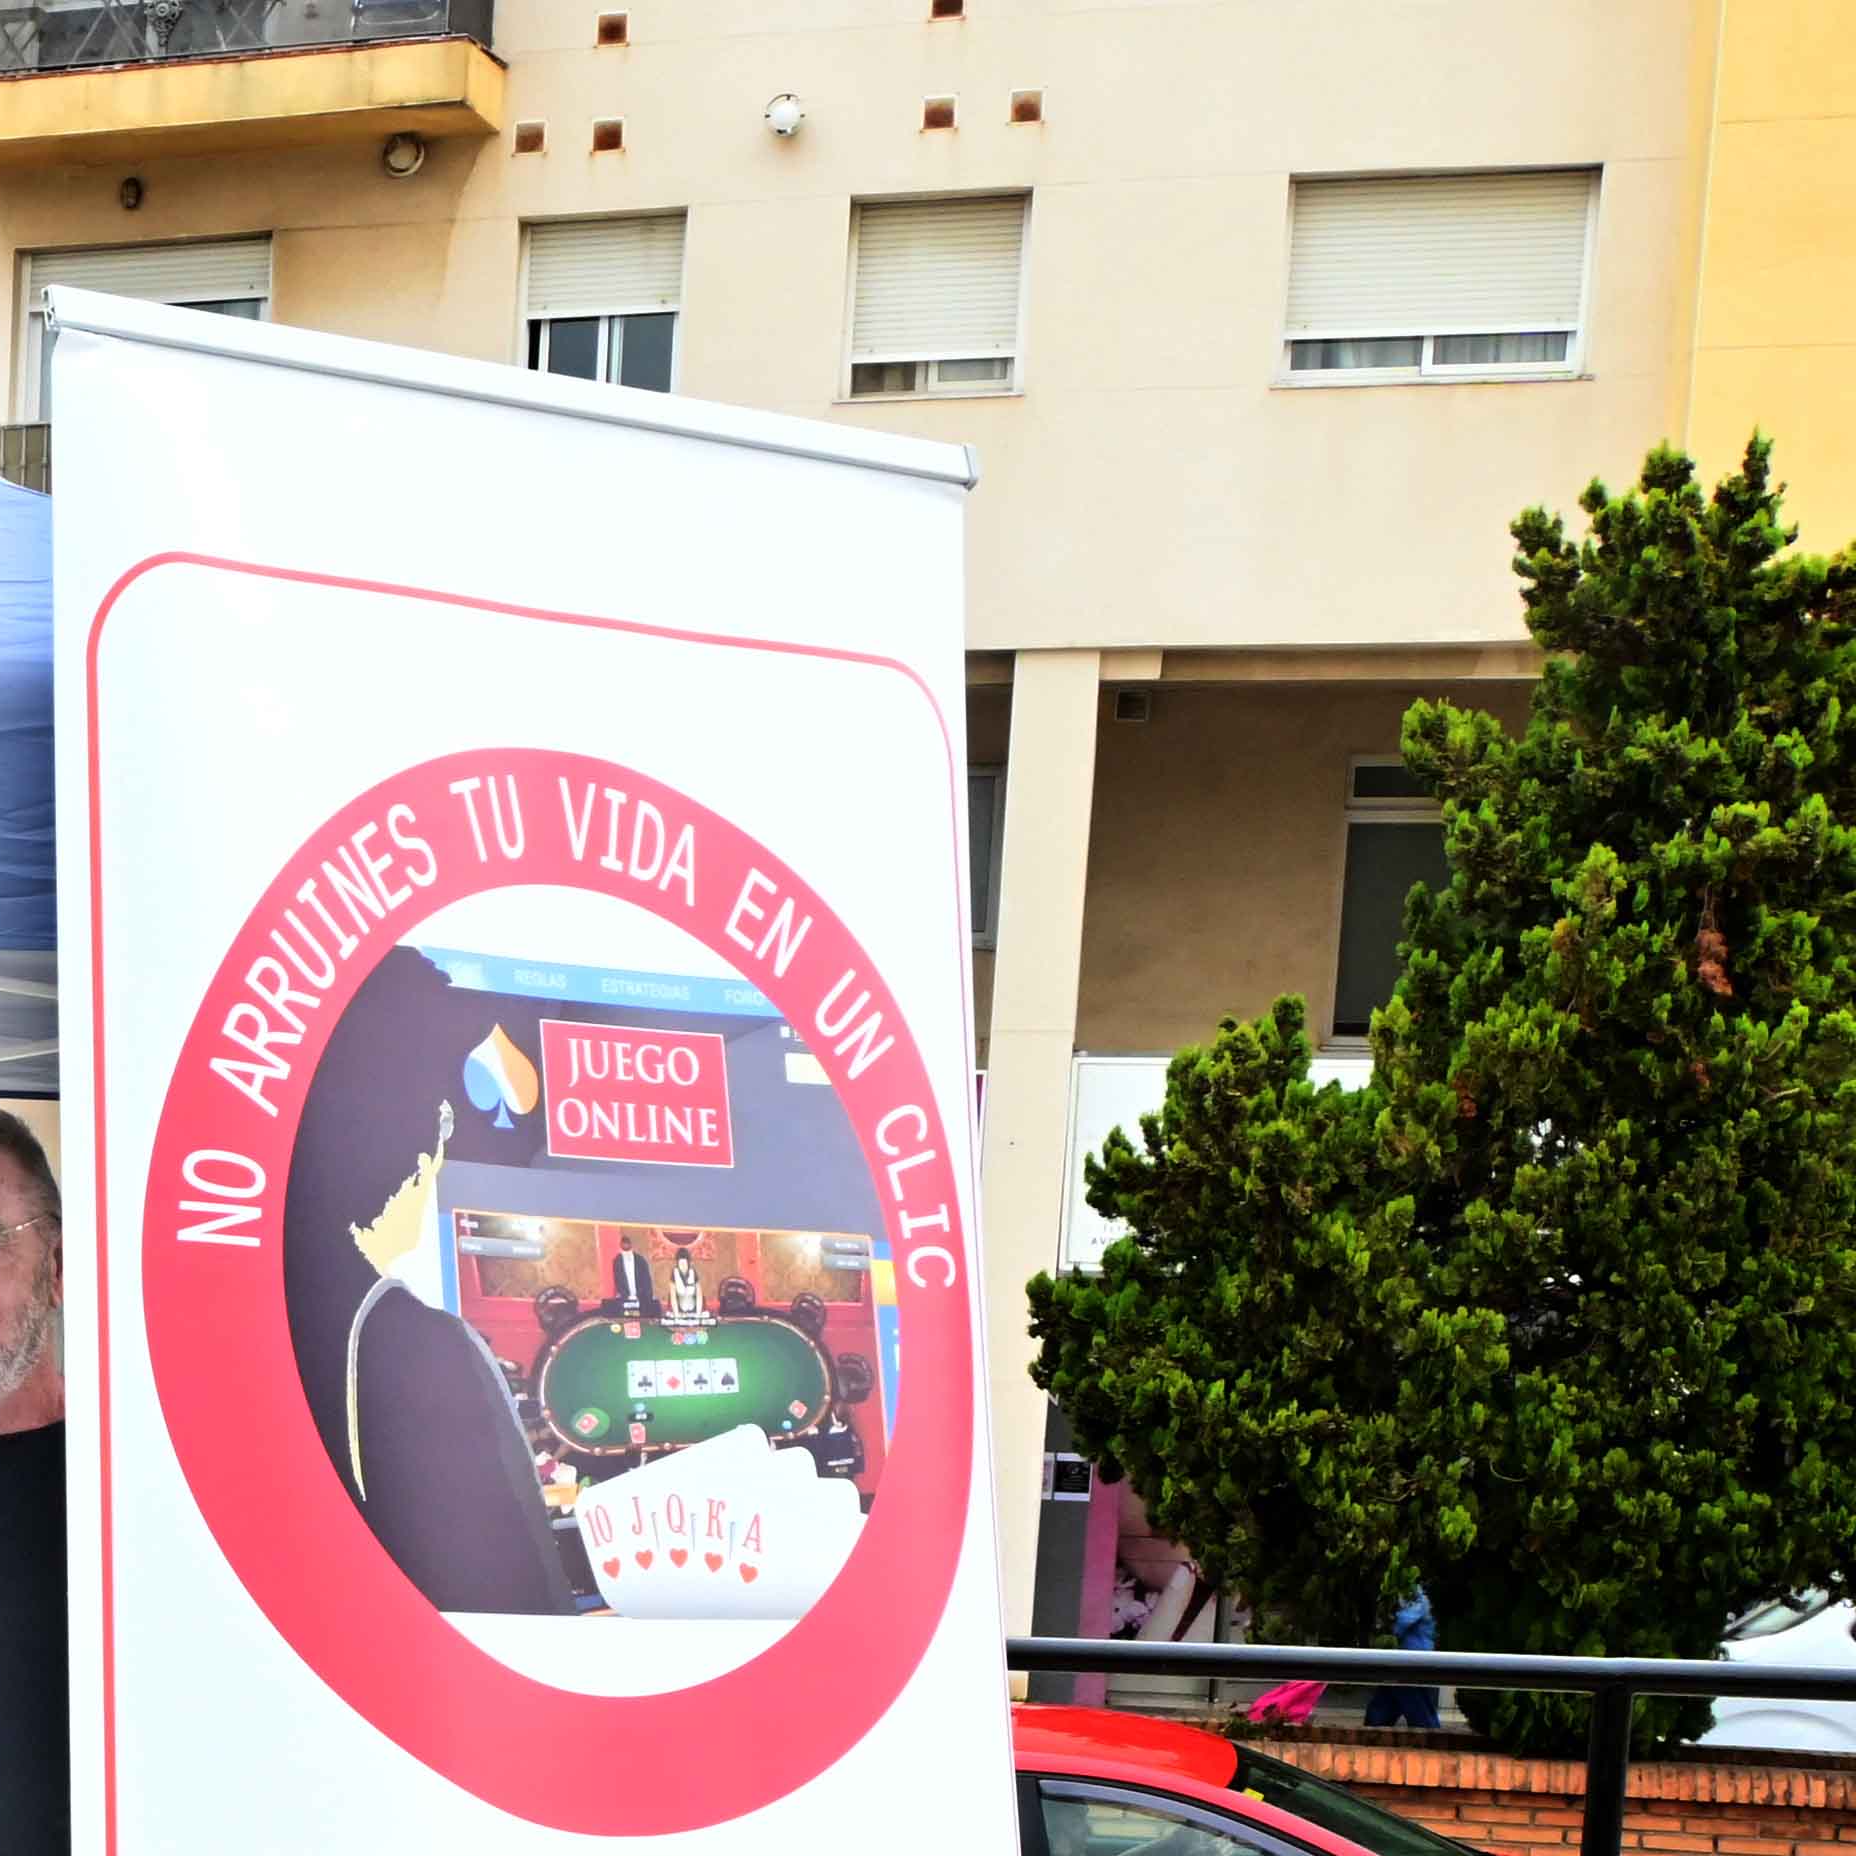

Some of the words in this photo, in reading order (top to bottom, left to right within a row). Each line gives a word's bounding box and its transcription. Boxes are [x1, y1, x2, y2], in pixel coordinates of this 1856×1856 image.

[449, 774, 525, 864] TU
[558, 776, 696, 907] VIDA
[724, 867, 813, 979] EN
[209, 803, 438, 1119] ARRUINES
[815, 968, 896, 1081] UN
[568, 1037, 700, 1088] JUEGO
[556, 1097, 720, 1147] ONLINE
[177, 1148, 267, 1248] NO
[874, 1103, 957, 1289] CLIC
[584, 1504, 614, 1548] 10
[631, 1496, 643, 1536] J
[665, 1493, 687, 1536] Q
[705, 1498, 727, 1540] K
[743, 1512, 763, 1553] A
